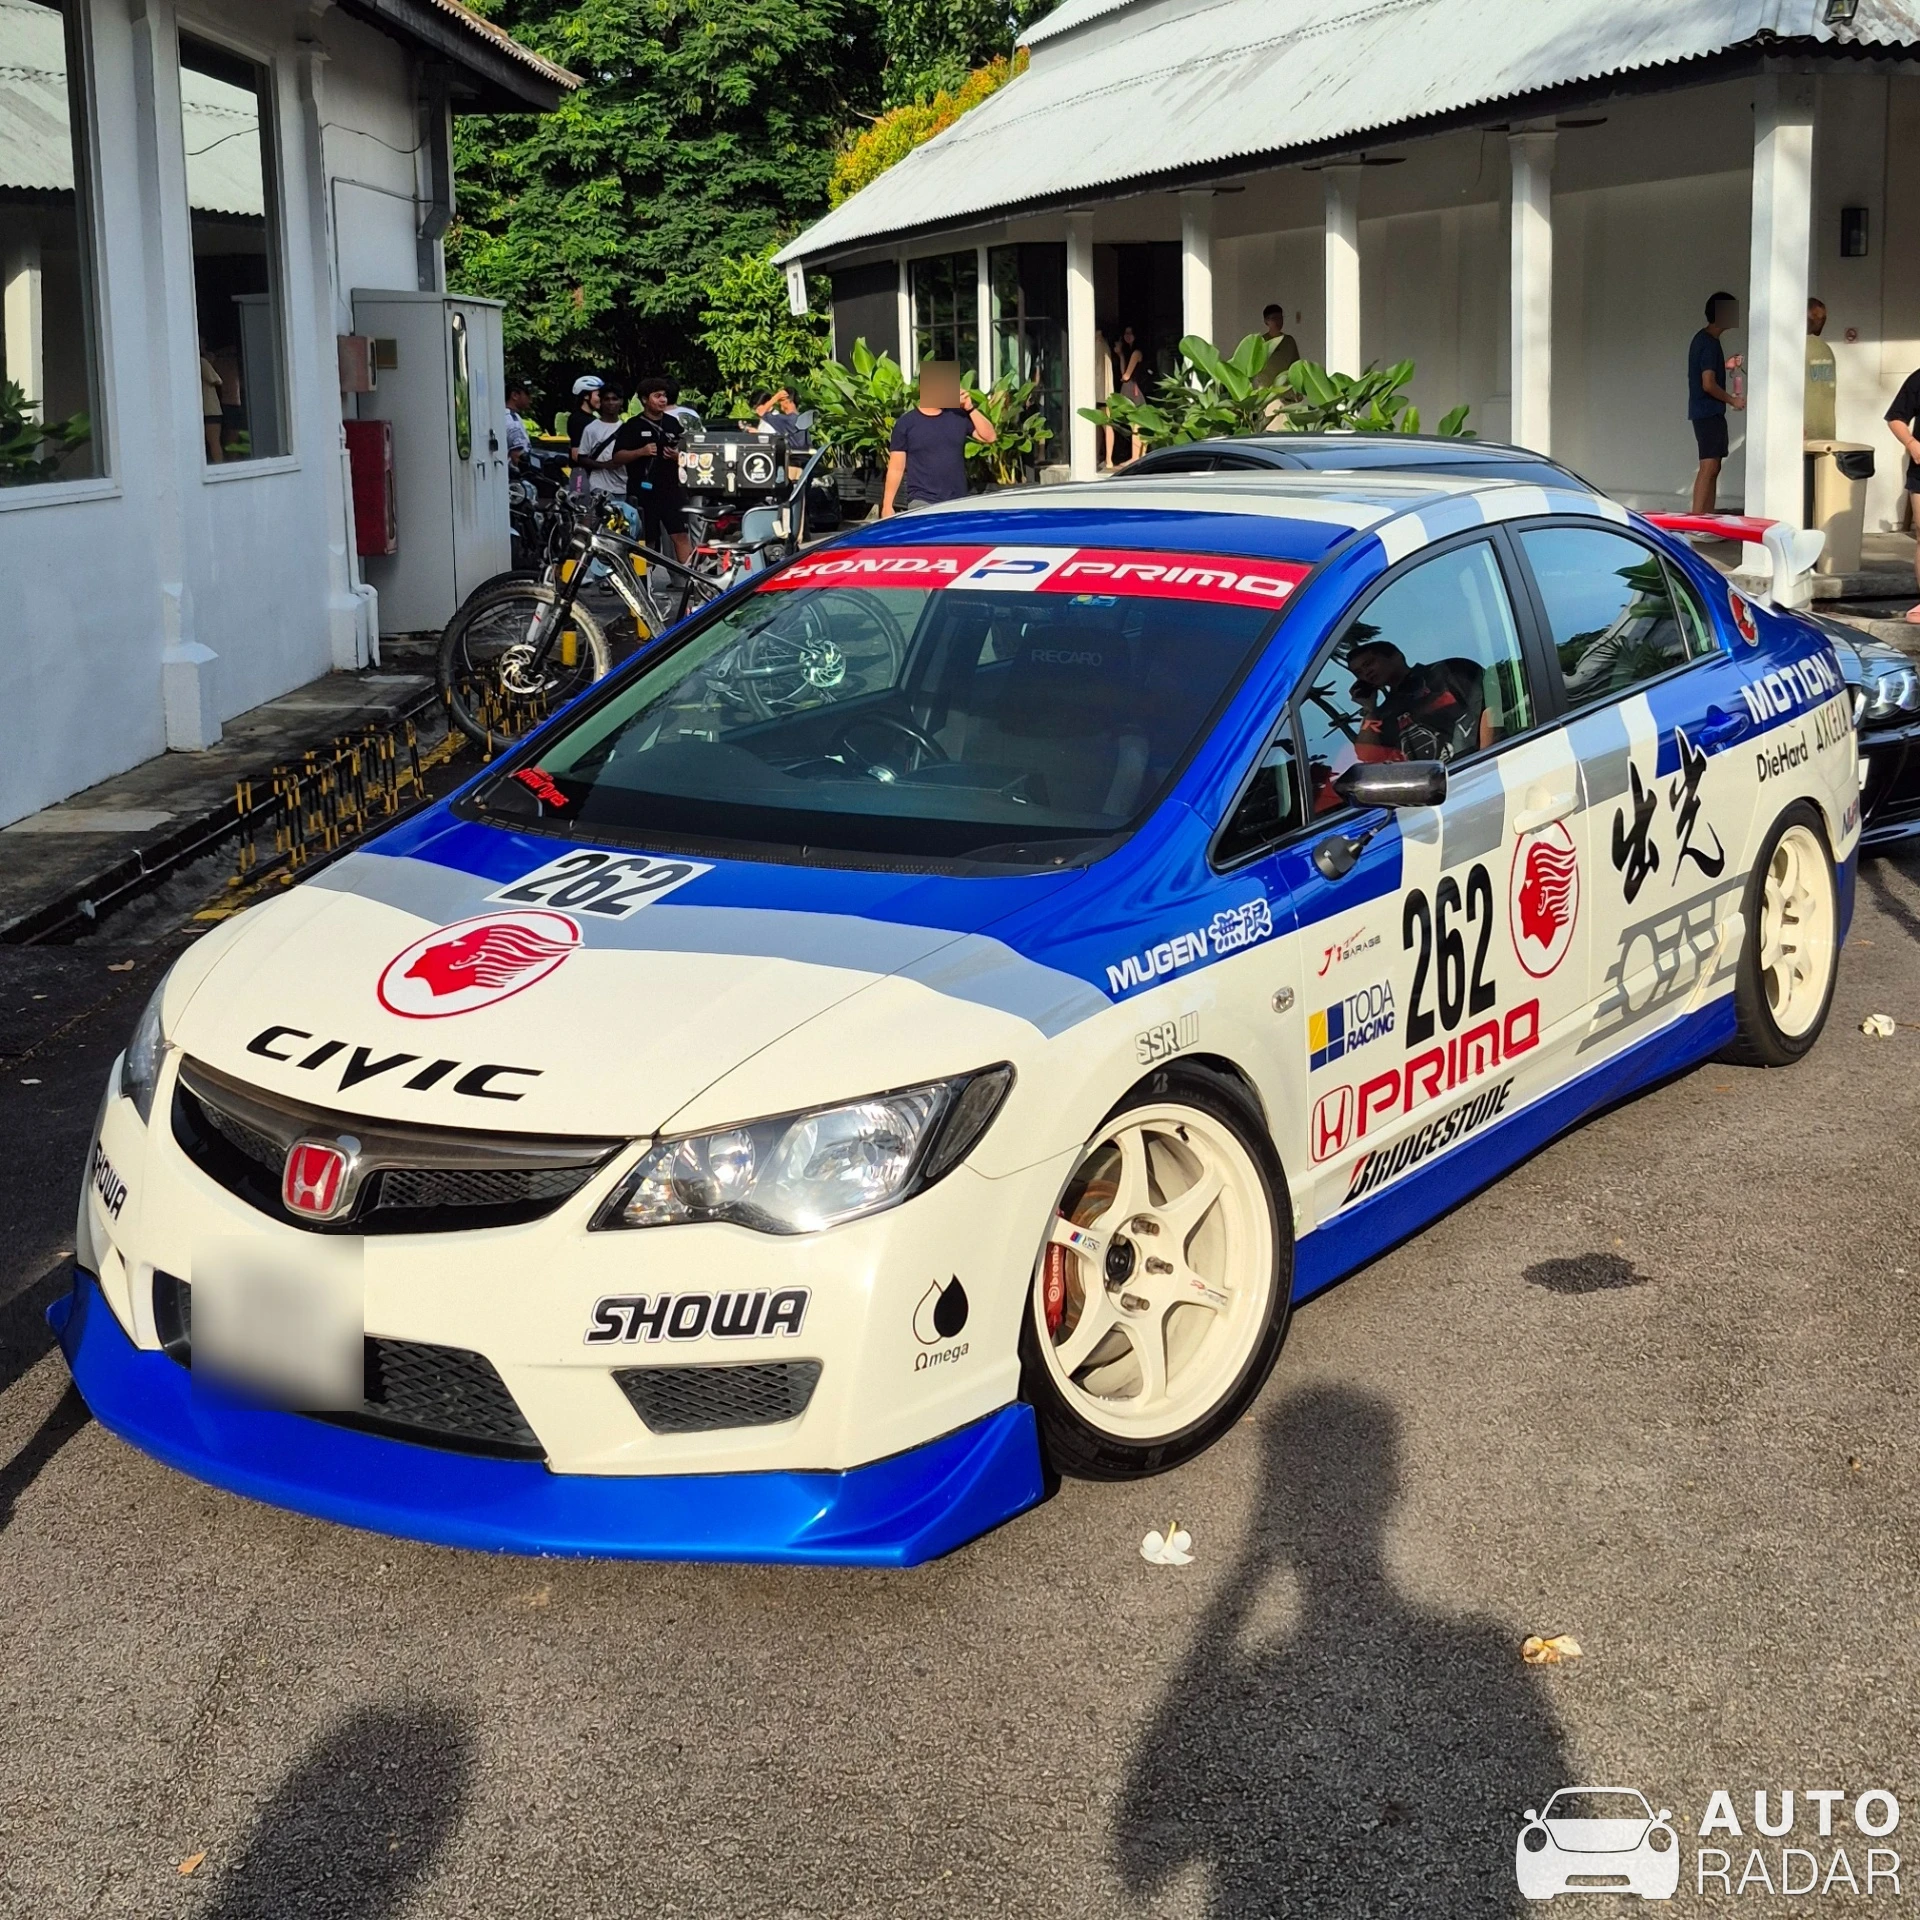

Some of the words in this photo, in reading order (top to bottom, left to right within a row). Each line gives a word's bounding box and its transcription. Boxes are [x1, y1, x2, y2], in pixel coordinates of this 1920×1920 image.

[753, 458, 765, 472] 2
[774, 557, 959, 581] HONDA
[1059, 561, 1295, 598] PRIMO
[1031, 650, 1101, 667] RECARO
[1740, 651, 1836, 725] MOTION
[1757, 730, 1808, 783] DieHard
[498, 853, 694, 916] 262
[1105, 928, 1208, 994] MUGEN
[1342, 935, 1381, 960] GARAGE
[1402, 862, 1496, 1049] 262
[1345, 979, 1395, 1029] TODA
[1134, 1021, 1181, 1066] SSR
[1346, 1011, 1395, 1054] RACING
[246, 1025, 545, 1101] CIVIC
[1357, 998, 1540, 1139] PRIMO
[1339, 1076, 1515, 1208] BRIDGESTONE
[1049, 1244, 1060, 1286] bremb
[584, 1287, 811, 1344] SHOWA
